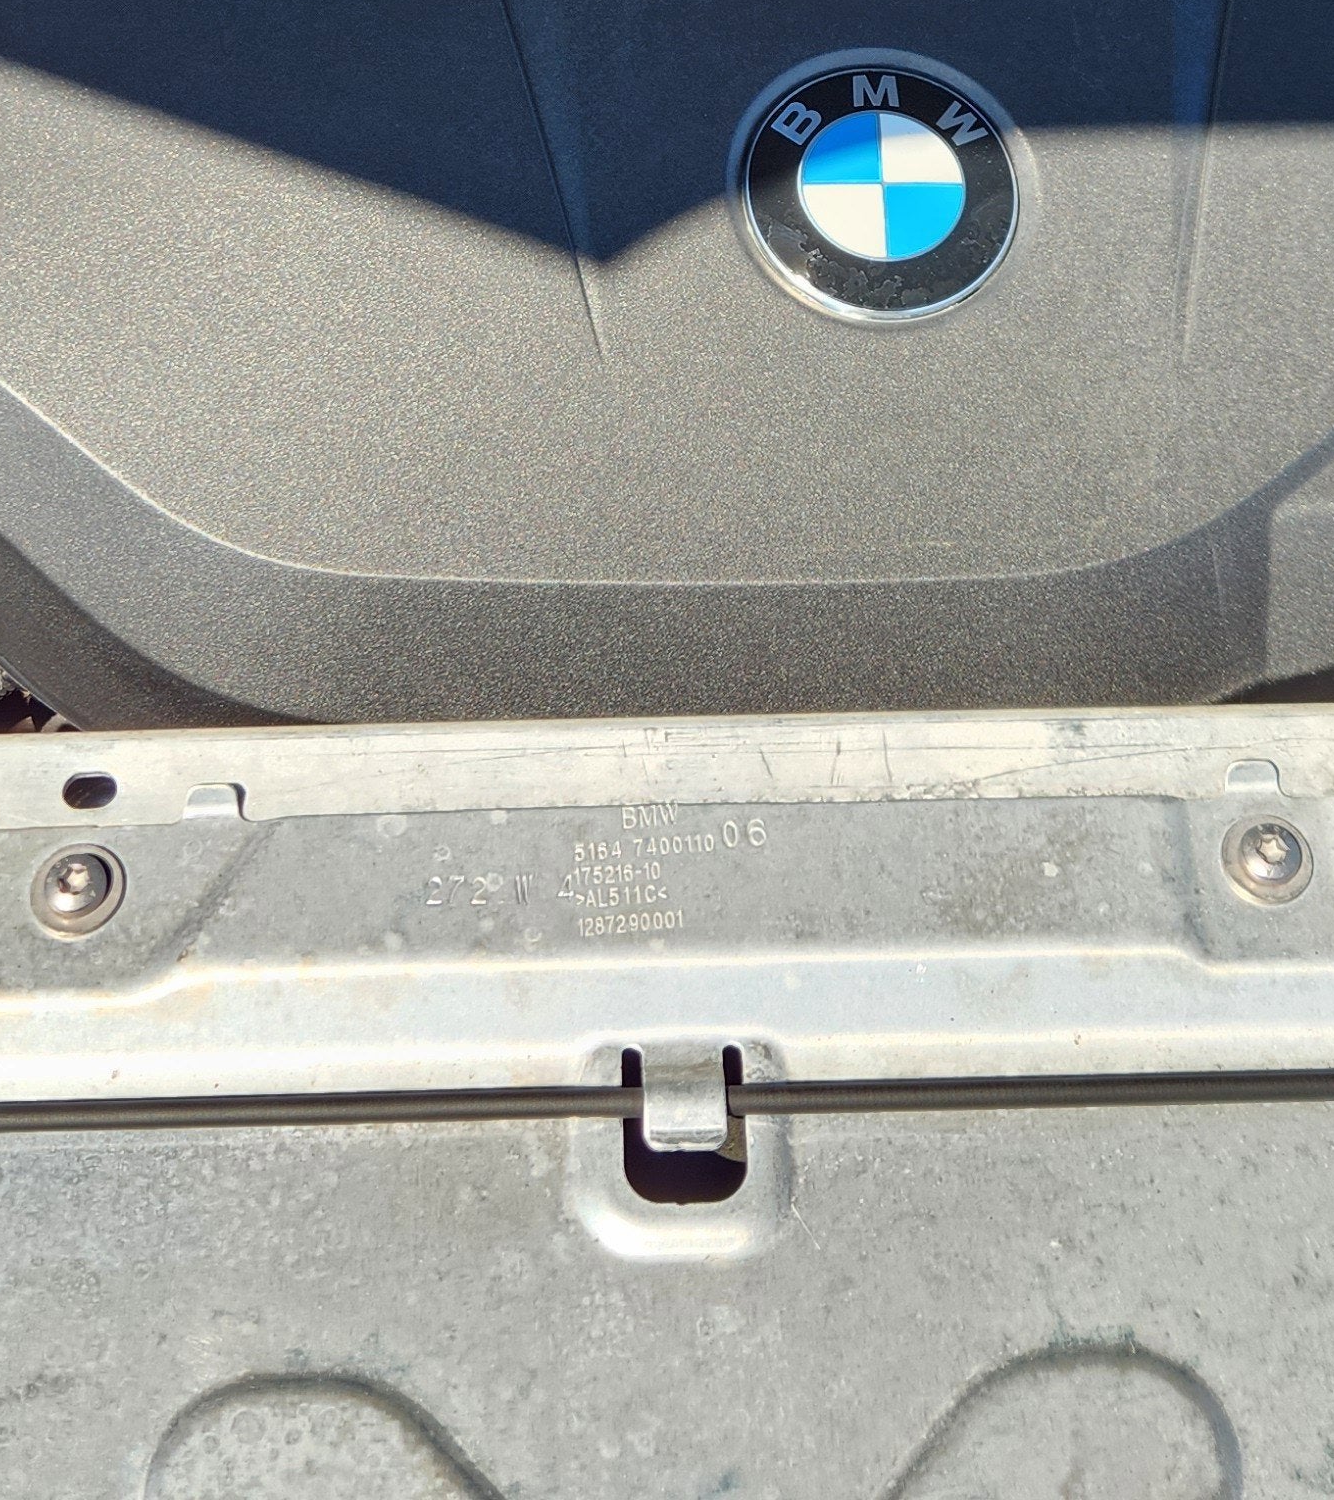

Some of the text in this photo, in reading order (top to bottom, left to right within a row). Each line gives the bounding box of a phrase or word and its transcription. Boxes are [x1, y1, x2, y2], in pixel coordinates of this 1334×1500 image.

[771, 74, 989, 147] BMW
[622, 801, 679, 830] BMW
[574, 840, 622, 862] 5164
[633, 833, 715, 857] 7400110
[573, 861, 662, 886] 175216-10
[578, 908, 684, 937] 1287290001
